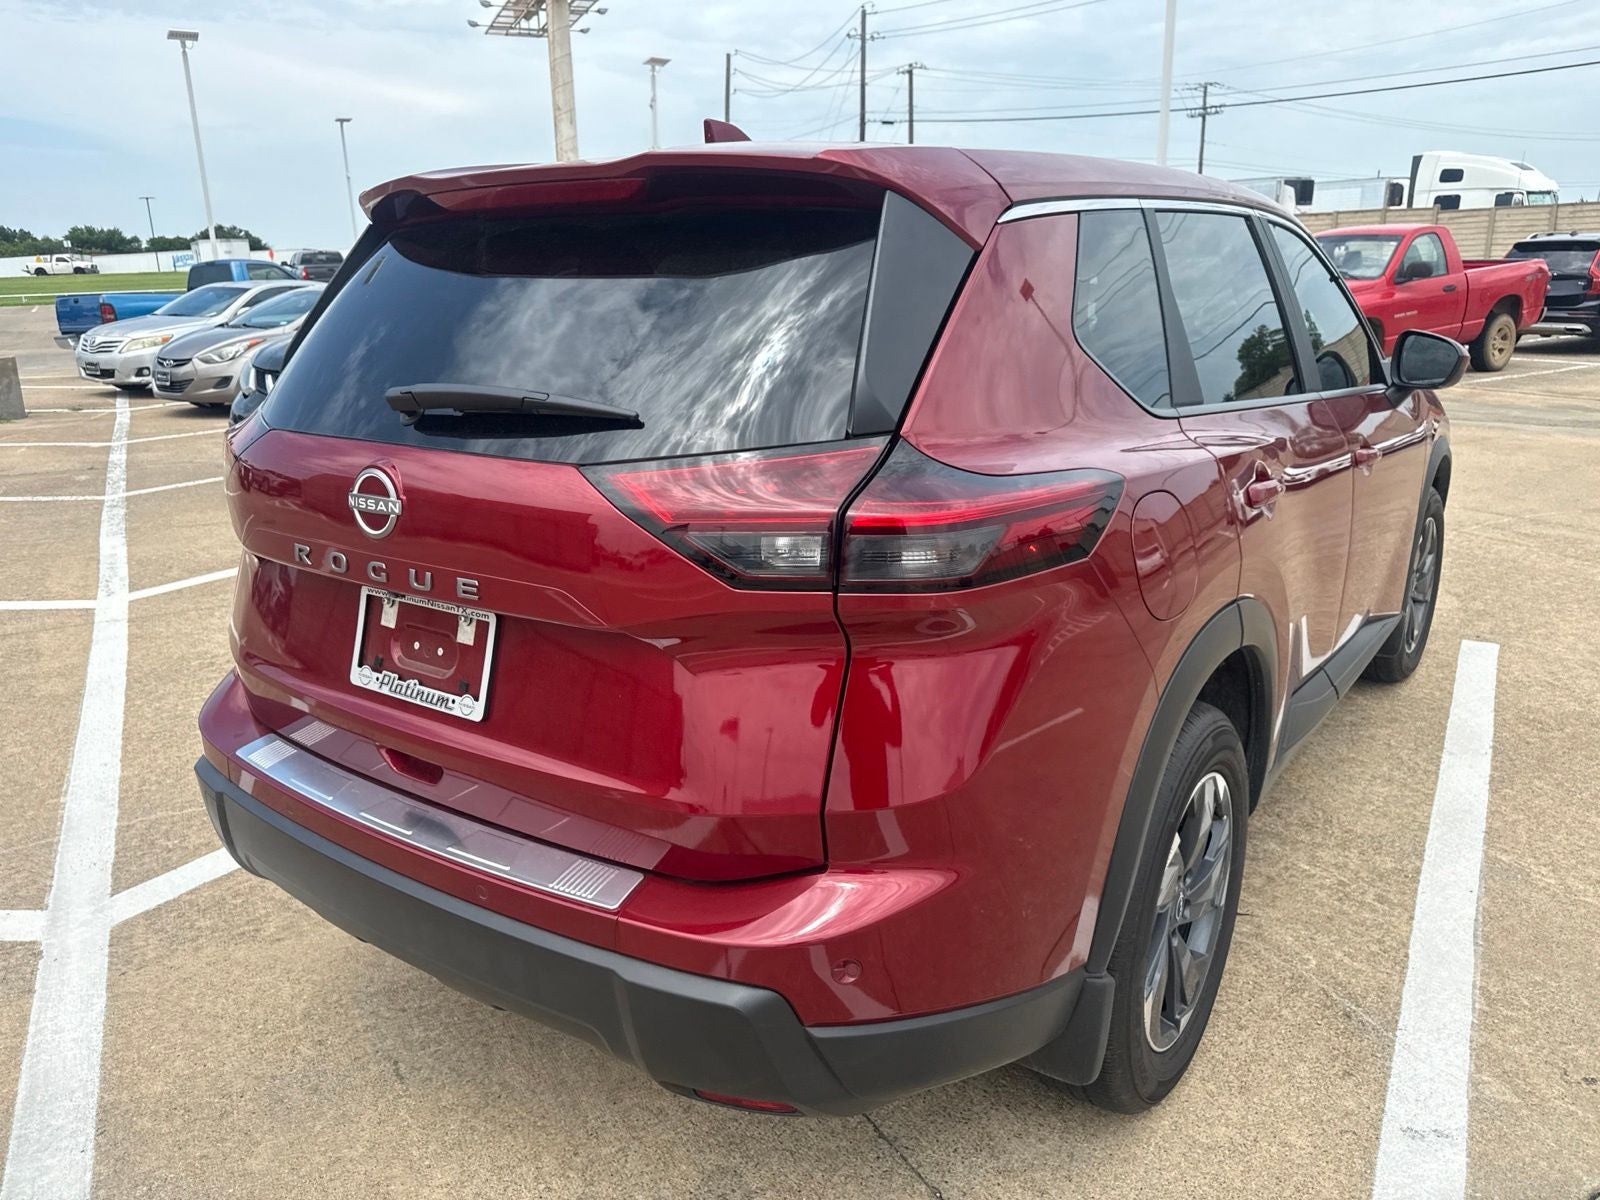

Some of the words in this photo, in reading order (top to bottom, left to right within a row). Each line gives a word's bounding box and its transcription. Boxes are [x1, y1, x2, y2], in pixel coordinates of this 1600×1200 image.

[349, 495, 400, 514] NISSAN
[294, 543, 479, 600] ROGUE
[379, 674, 454, 711] Platinum
